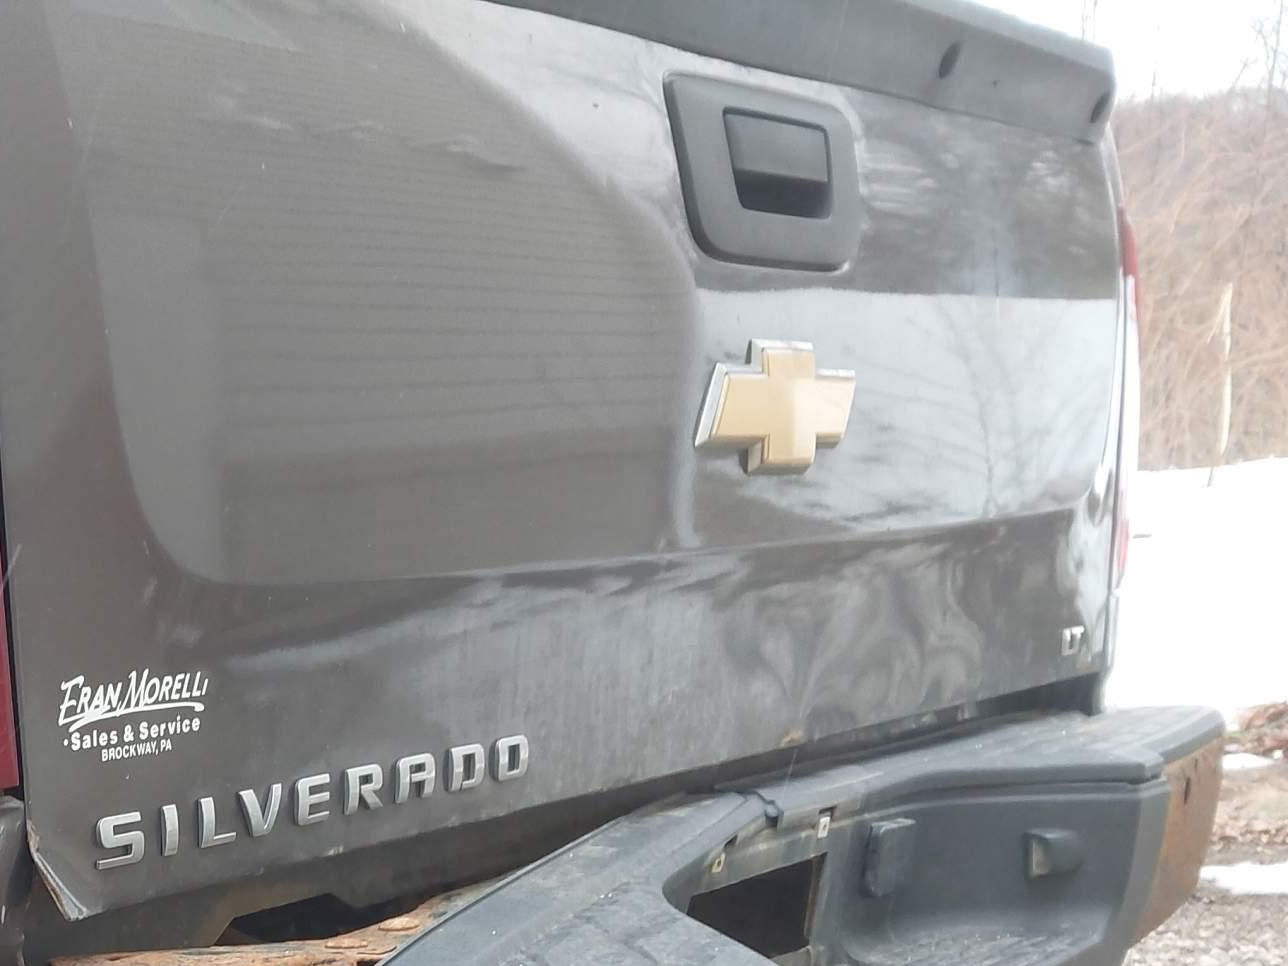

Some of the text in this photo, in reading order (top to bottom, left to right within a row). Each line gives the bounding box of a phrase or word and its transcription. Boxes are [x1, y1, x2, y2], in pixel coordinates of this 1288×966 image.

[1062, 625, 1085, 656] LT
[123, 724, 135, 742] &
[139, 715, 201, 740] Service
[101, 738, 172, 762] BROCKWAY, PA
[95, 733, 529, 870] SILVERADO
